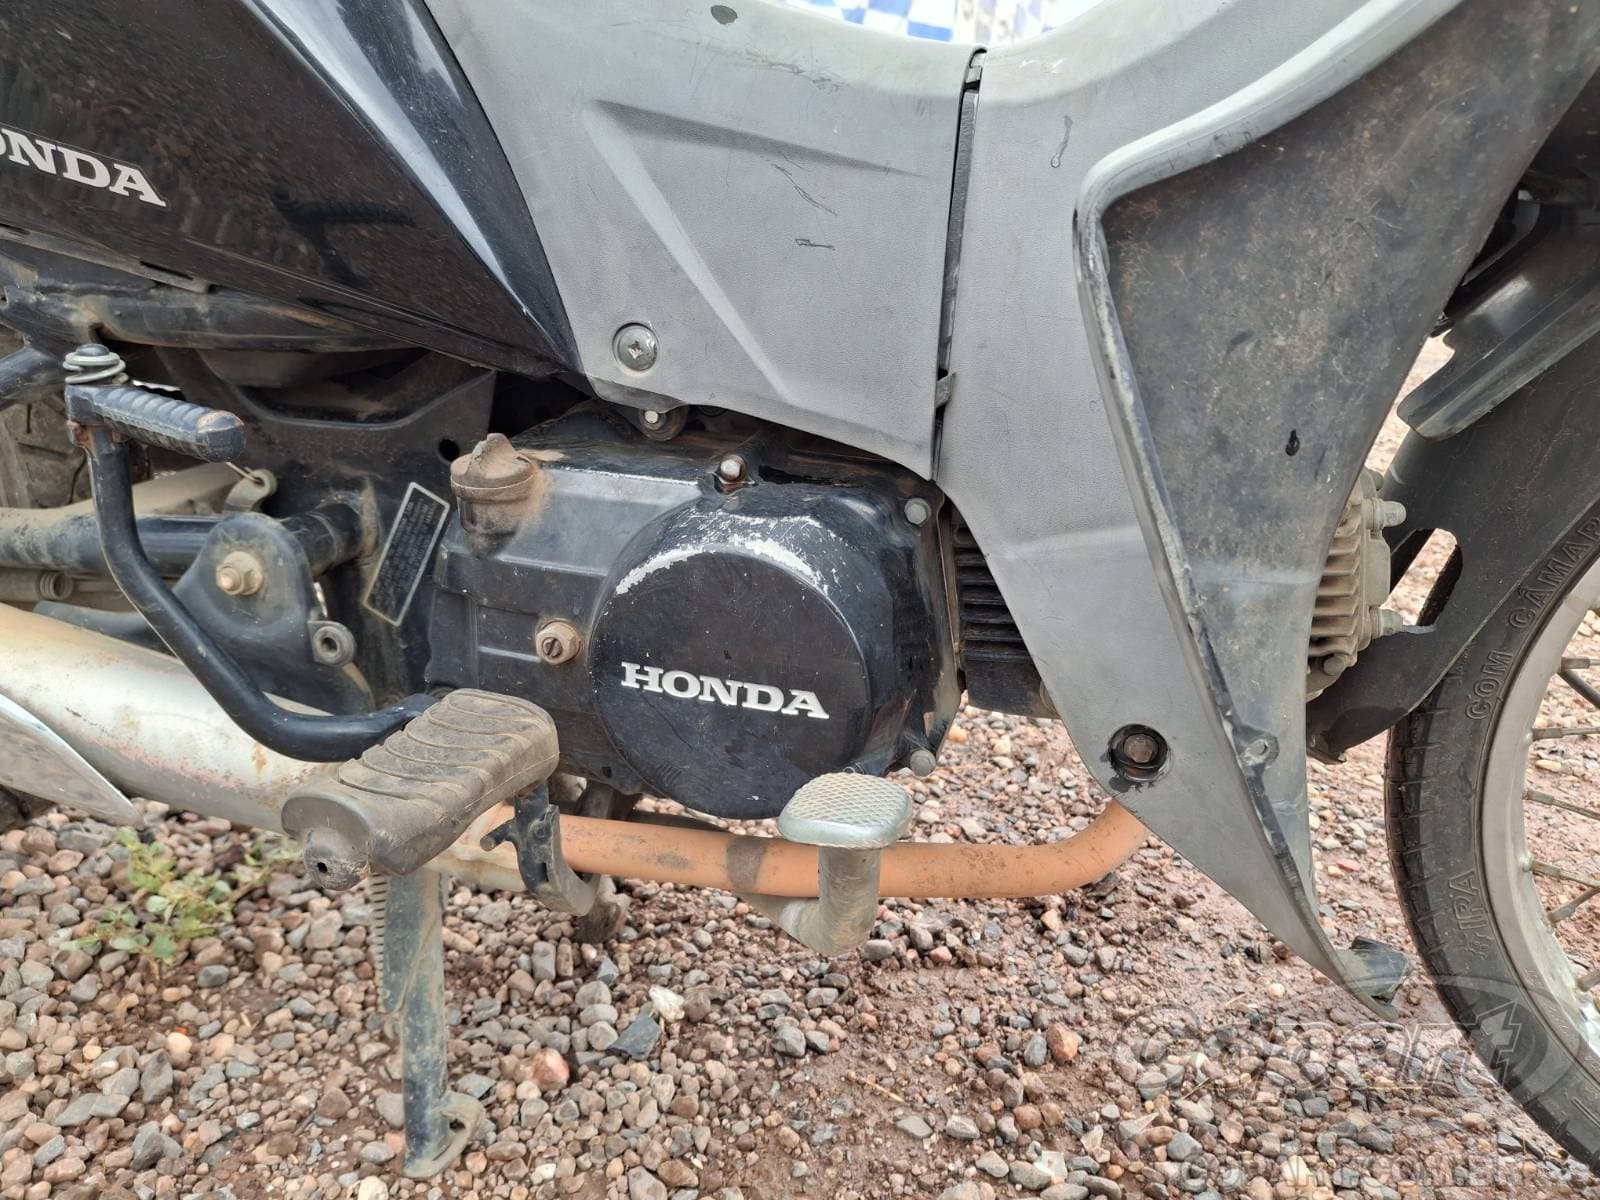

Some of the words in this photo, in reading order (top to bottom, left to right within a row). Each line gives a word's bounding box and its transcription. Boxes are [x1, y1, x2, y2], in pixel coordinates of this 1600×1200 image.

[0, 128, 167, 208] NDA
[620, 661, 830, 719] HONDA
[1464, 649, 1514, 720] COM
